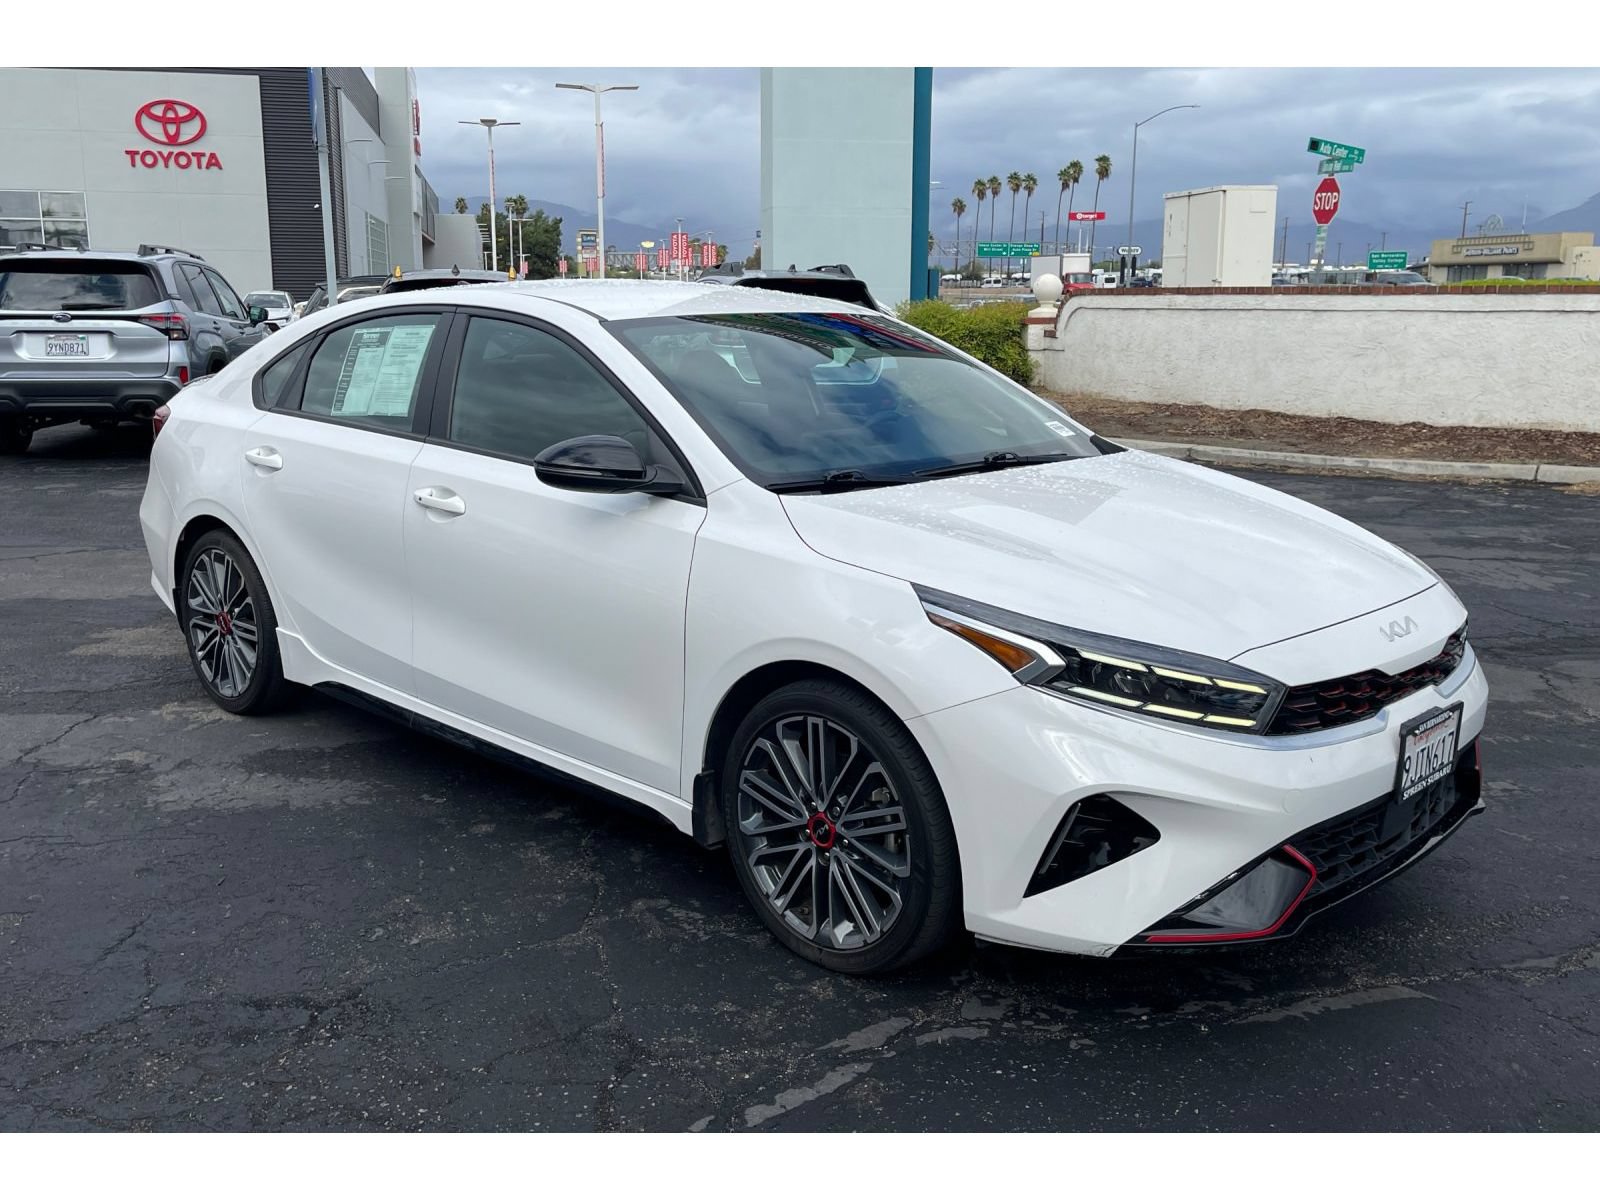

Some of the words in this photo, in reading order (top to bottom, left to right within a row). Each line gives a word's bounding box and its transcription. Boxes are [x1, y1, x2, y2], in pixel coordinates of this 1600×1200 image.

[1320, 142, 1332, 154] Auto
[125, 150, 223, 170] TOYOTA
[1314, 192, 1339, 211] STOP
[48, 342, 85, 353] 9YND871
[1380, 615, 1418, 642] KIA
[1403, 778, 1427, 800] SPREEN
[1427, 763, 1453, 785] SUBARU
